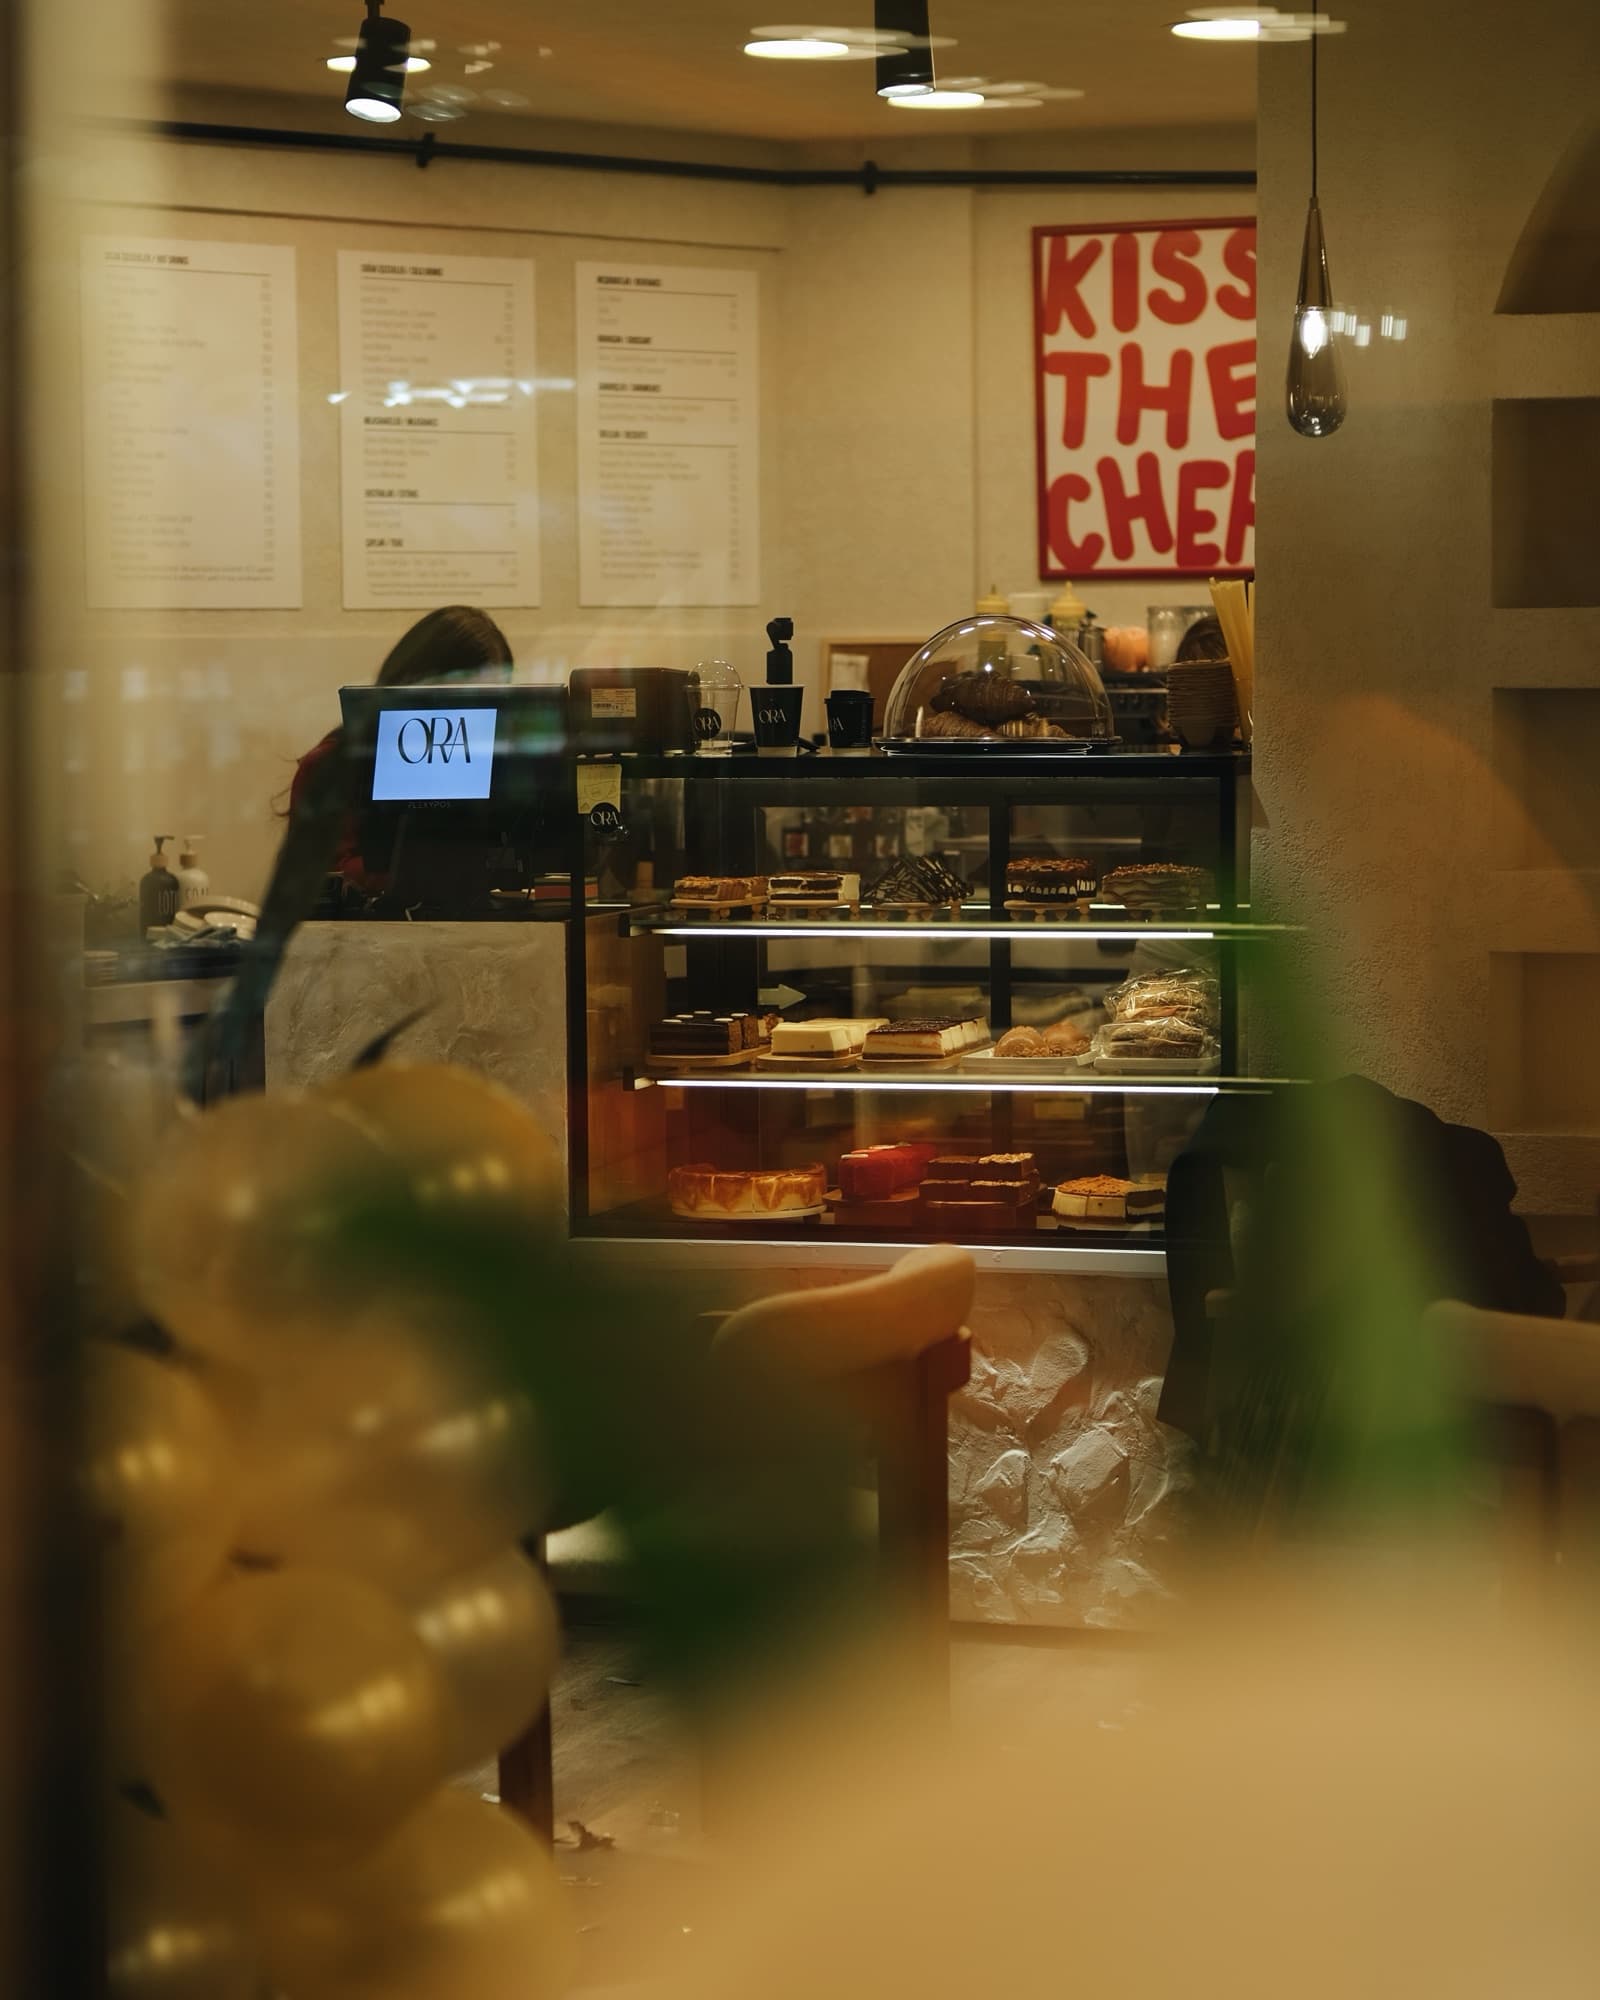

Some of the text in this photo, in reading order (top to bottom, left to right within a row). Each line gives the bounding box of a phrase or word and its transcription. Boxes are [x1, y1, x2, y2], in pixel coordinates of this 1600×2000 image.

[1042, 228, 1257, 339] KISS
[1042, 338, 1257, 450] THE
[694, 715, 720, 731] ORA
[758, 708, 787, 724] ORA
[397, 716, 471, 765] ORA
[590, 810, 619, 826] ORA
